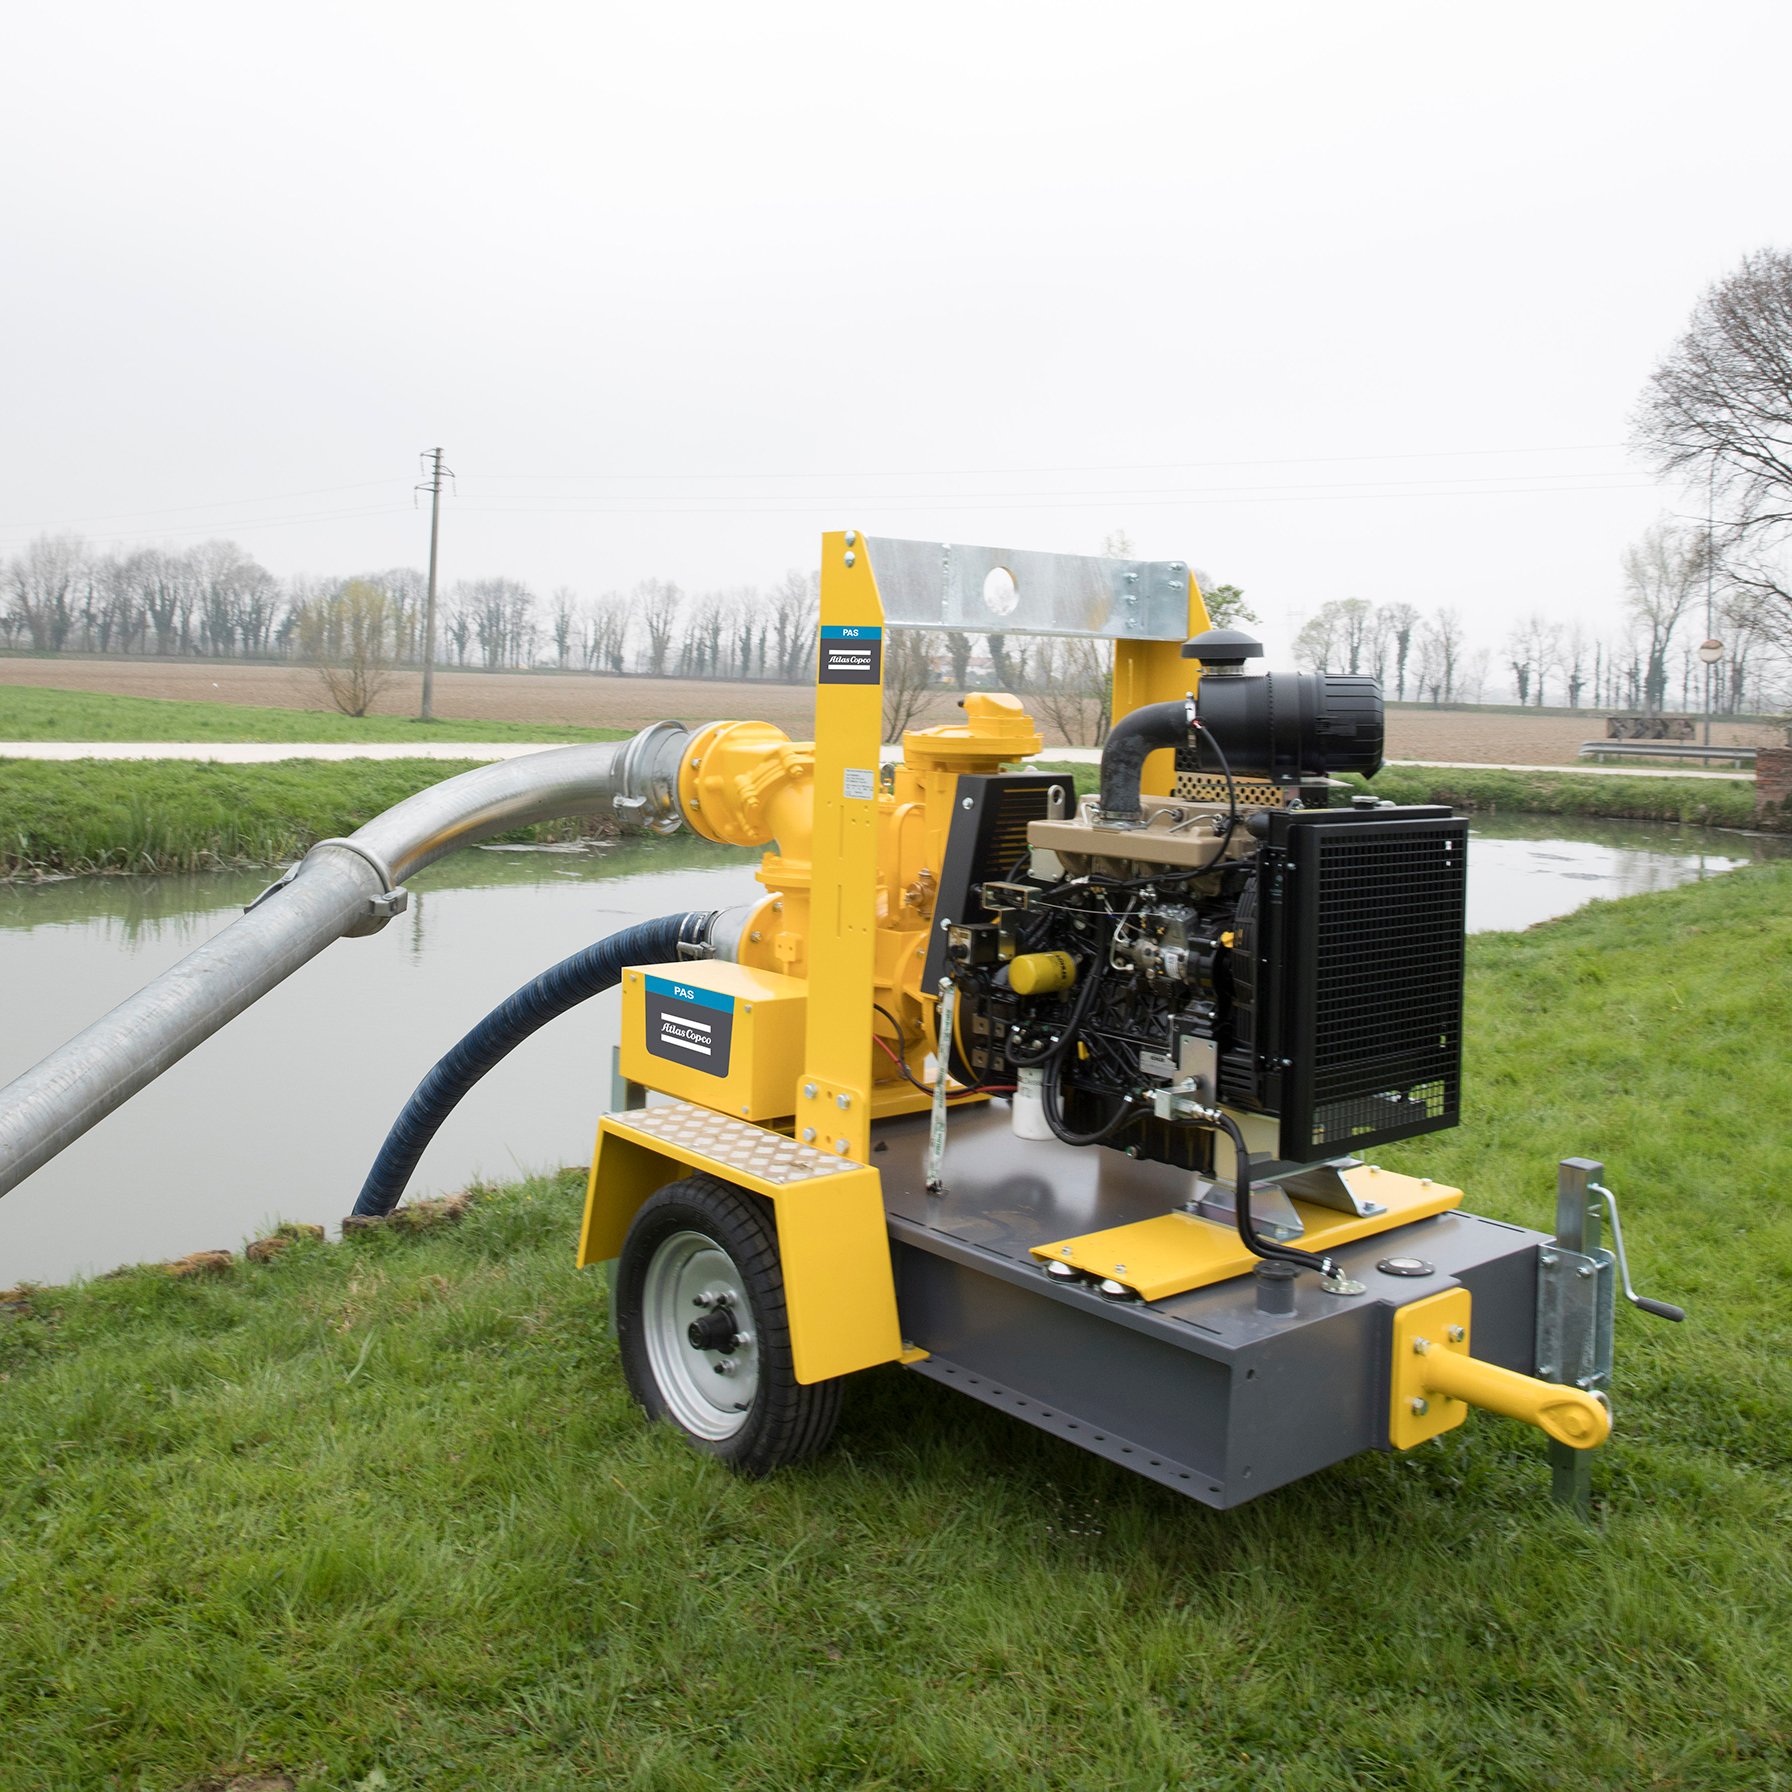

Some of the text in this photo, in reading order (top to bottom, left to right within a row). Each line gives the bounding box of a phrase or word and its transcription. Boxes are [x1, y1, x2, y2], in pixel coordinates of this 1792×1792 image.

[842, 628, 859, 637] PAS
[828, 655, 871, 664] Atlas Copco
[674, 986, 695, 1000] PAS
[661, 1022, 712, 1045] Atlas Copco
